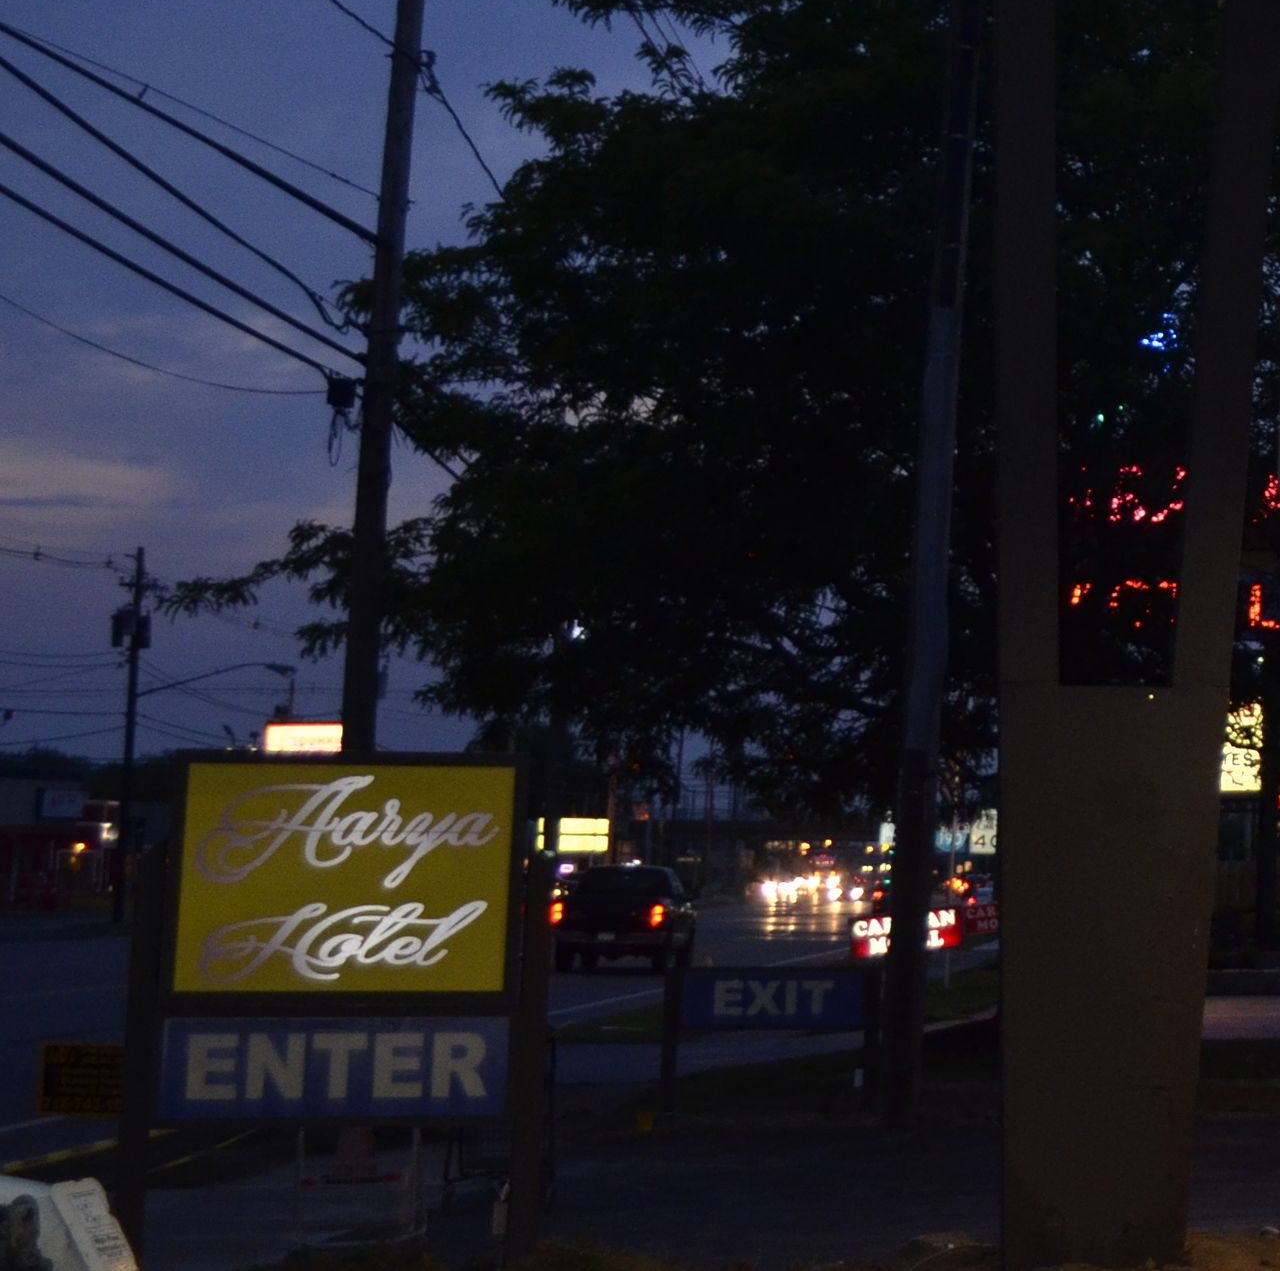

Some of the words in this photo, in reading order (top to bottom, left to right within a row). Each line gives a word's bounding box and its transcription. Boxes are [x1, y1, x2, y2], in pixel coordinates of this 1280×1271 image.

[195, 774, 500, 889] Aarya
[195, 900, 489, 984] Hotel
[713, 978, 836, 1016] EXIT
[184, 1031, 489, 1101] ENTER
